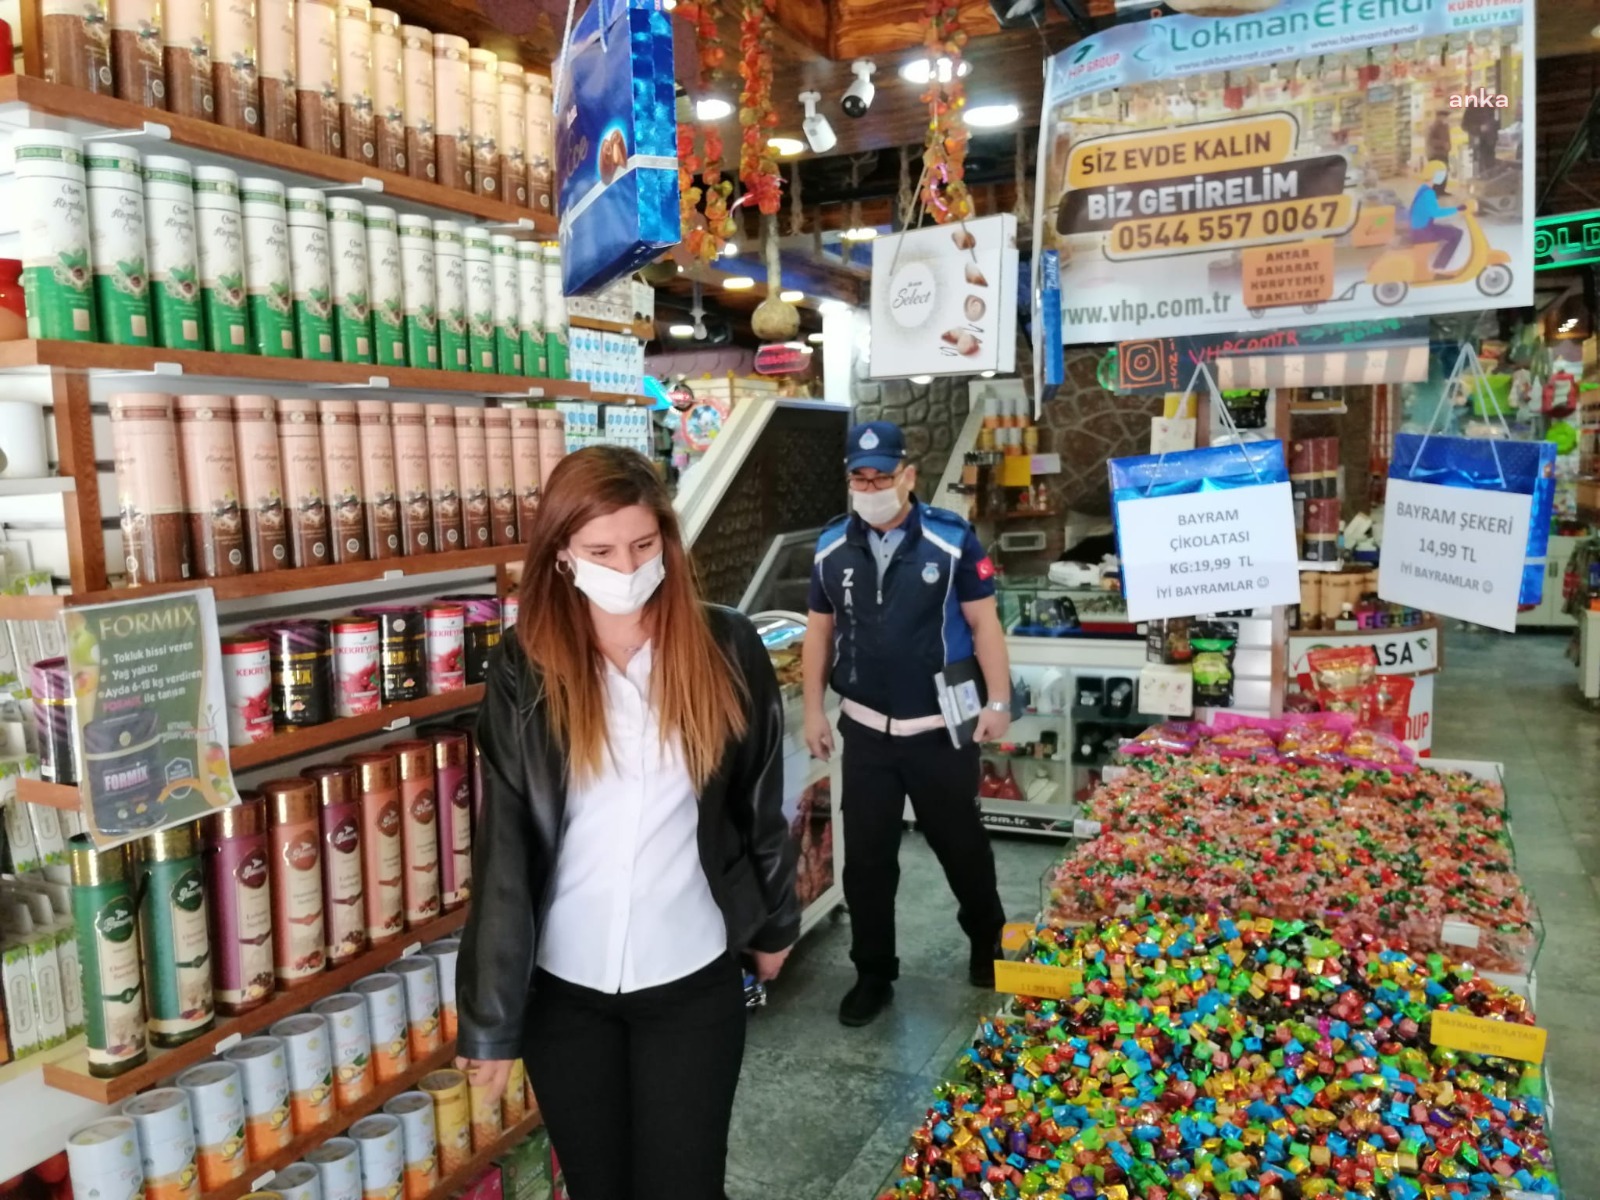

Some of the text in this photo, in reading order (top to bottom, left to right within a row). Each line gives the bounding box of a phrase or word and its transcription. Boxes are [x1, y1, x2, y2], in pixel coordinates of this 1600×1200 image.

[1081, 131, 1271, 175] SİZ EVDE KALIN
[1088, 167, 1298, 220] BİZ GETİRELİM
[1118, 201, 1339, 251] 0544 557 0067
[892, 288, 931, 309] Select
[1062, 291, 1231, 326] ww.vhp.com.tr
[1178, 509, 1239, 526] BAYRAM
[1397, 501, 1514, 535] BAYRAM ŞEKERİ
[1170, 530, 1250, 552] ÇİKOLATASI
[1419, 538, 1477, 563] 14,99 TL
[1170, 556, 1254, 575] KG:19,99 TL
[1400, 561, 1480, 592] İYİ BAYRAMLAR
[1157, 580, 1253, 599] İYİ BAYRAMLAR
[100, 605, 196, 640] FORMIX
[113, 640, 193, 665] Tokluk hissi veren
[105, 683, 130, 699] Ayda
[152, 677, 164, 689] kg
[165, 669, 202, 685] verdiren
[144, 692, 156, 703] ile
